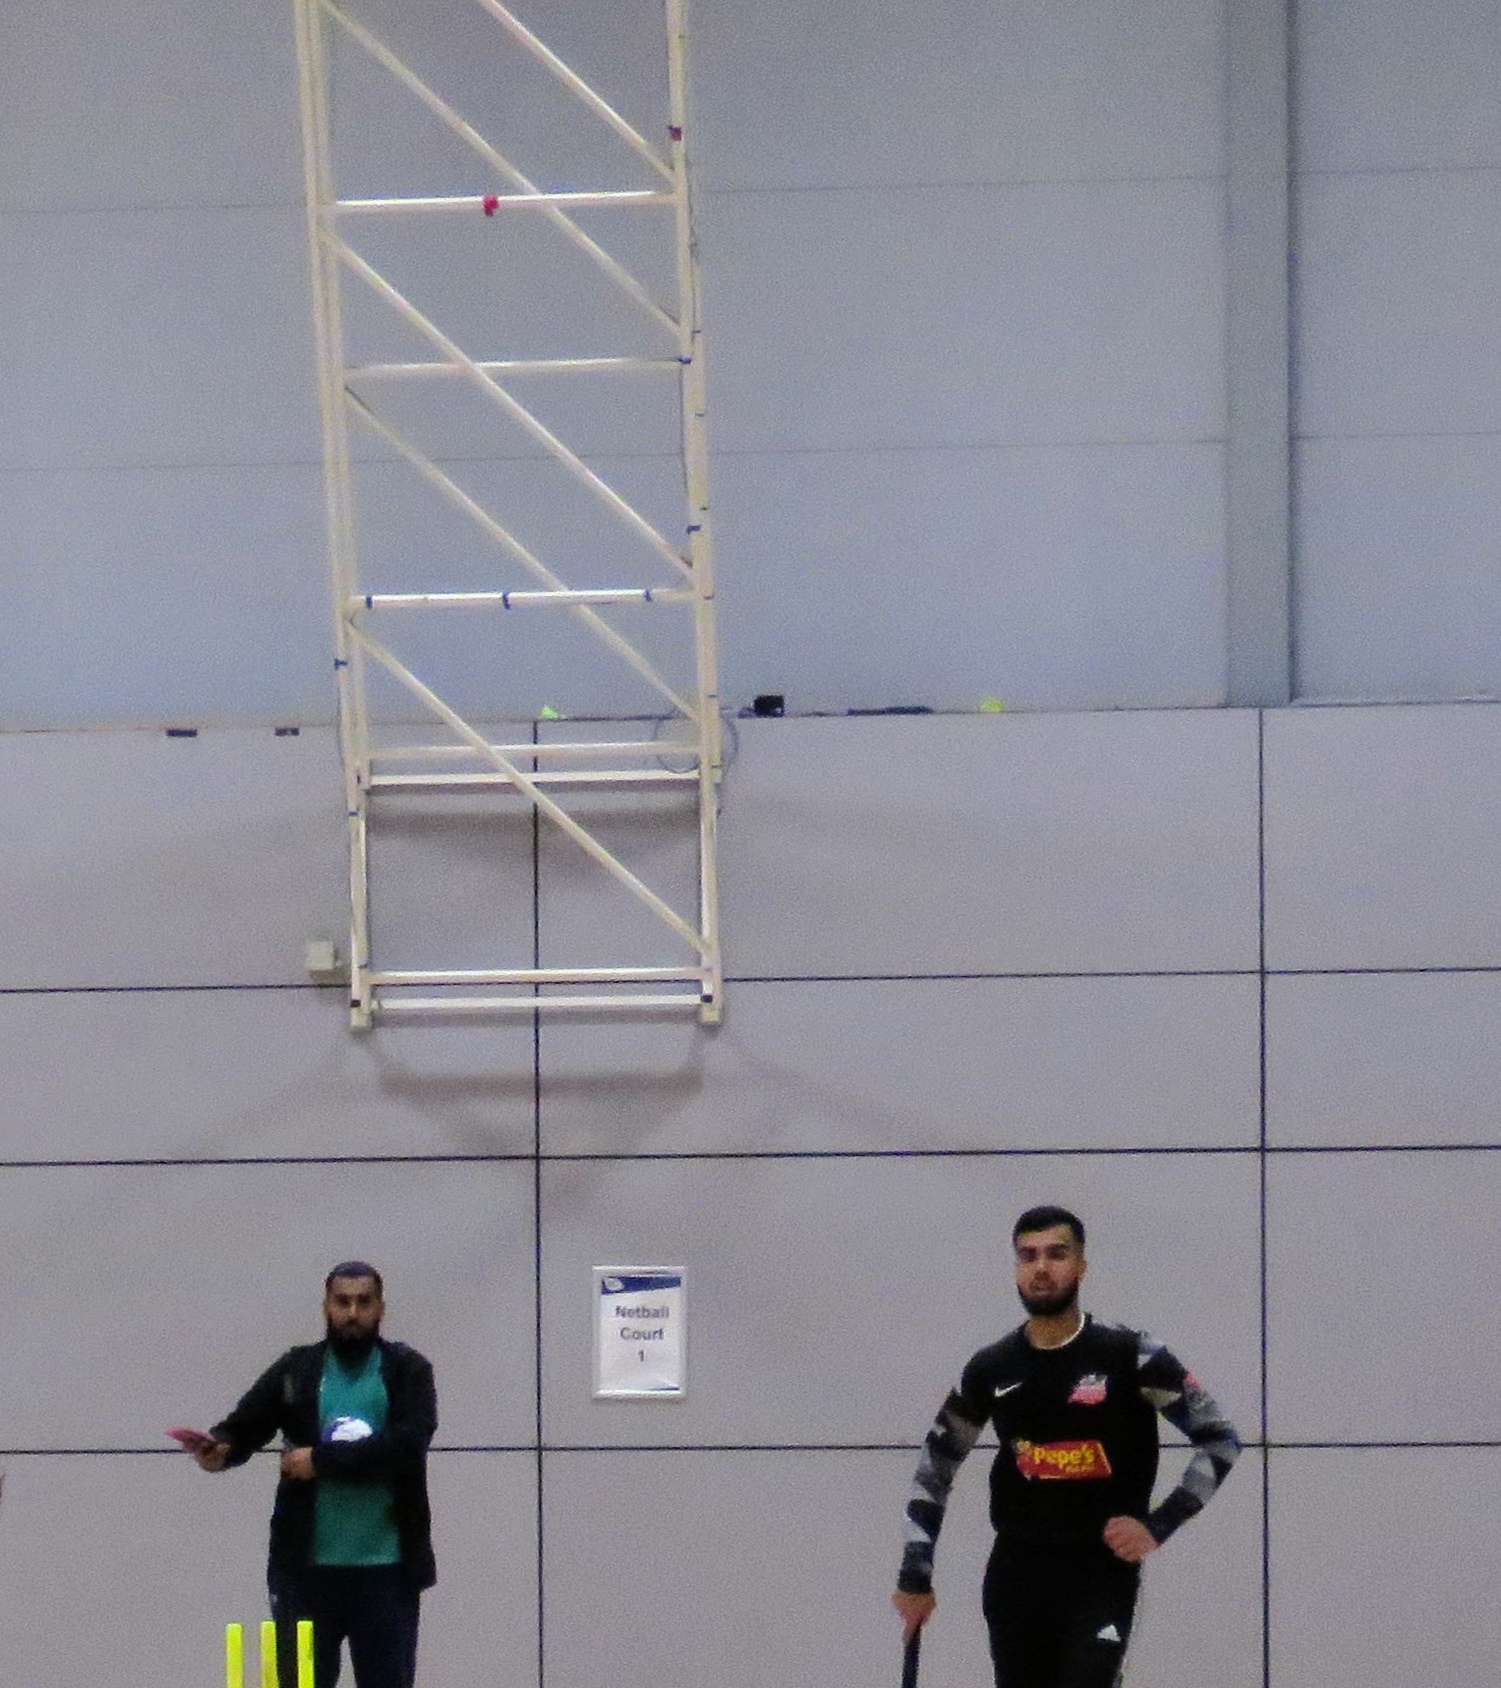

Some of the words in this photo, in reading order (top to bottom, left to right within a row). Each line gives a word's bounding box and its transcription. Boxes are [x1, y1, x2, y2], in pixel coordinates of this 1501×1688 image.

[614, 1304, 671, 1319] Netball
[619, 1326, 665, 1341] Court
[636, 1349, 646, 1362] 1
